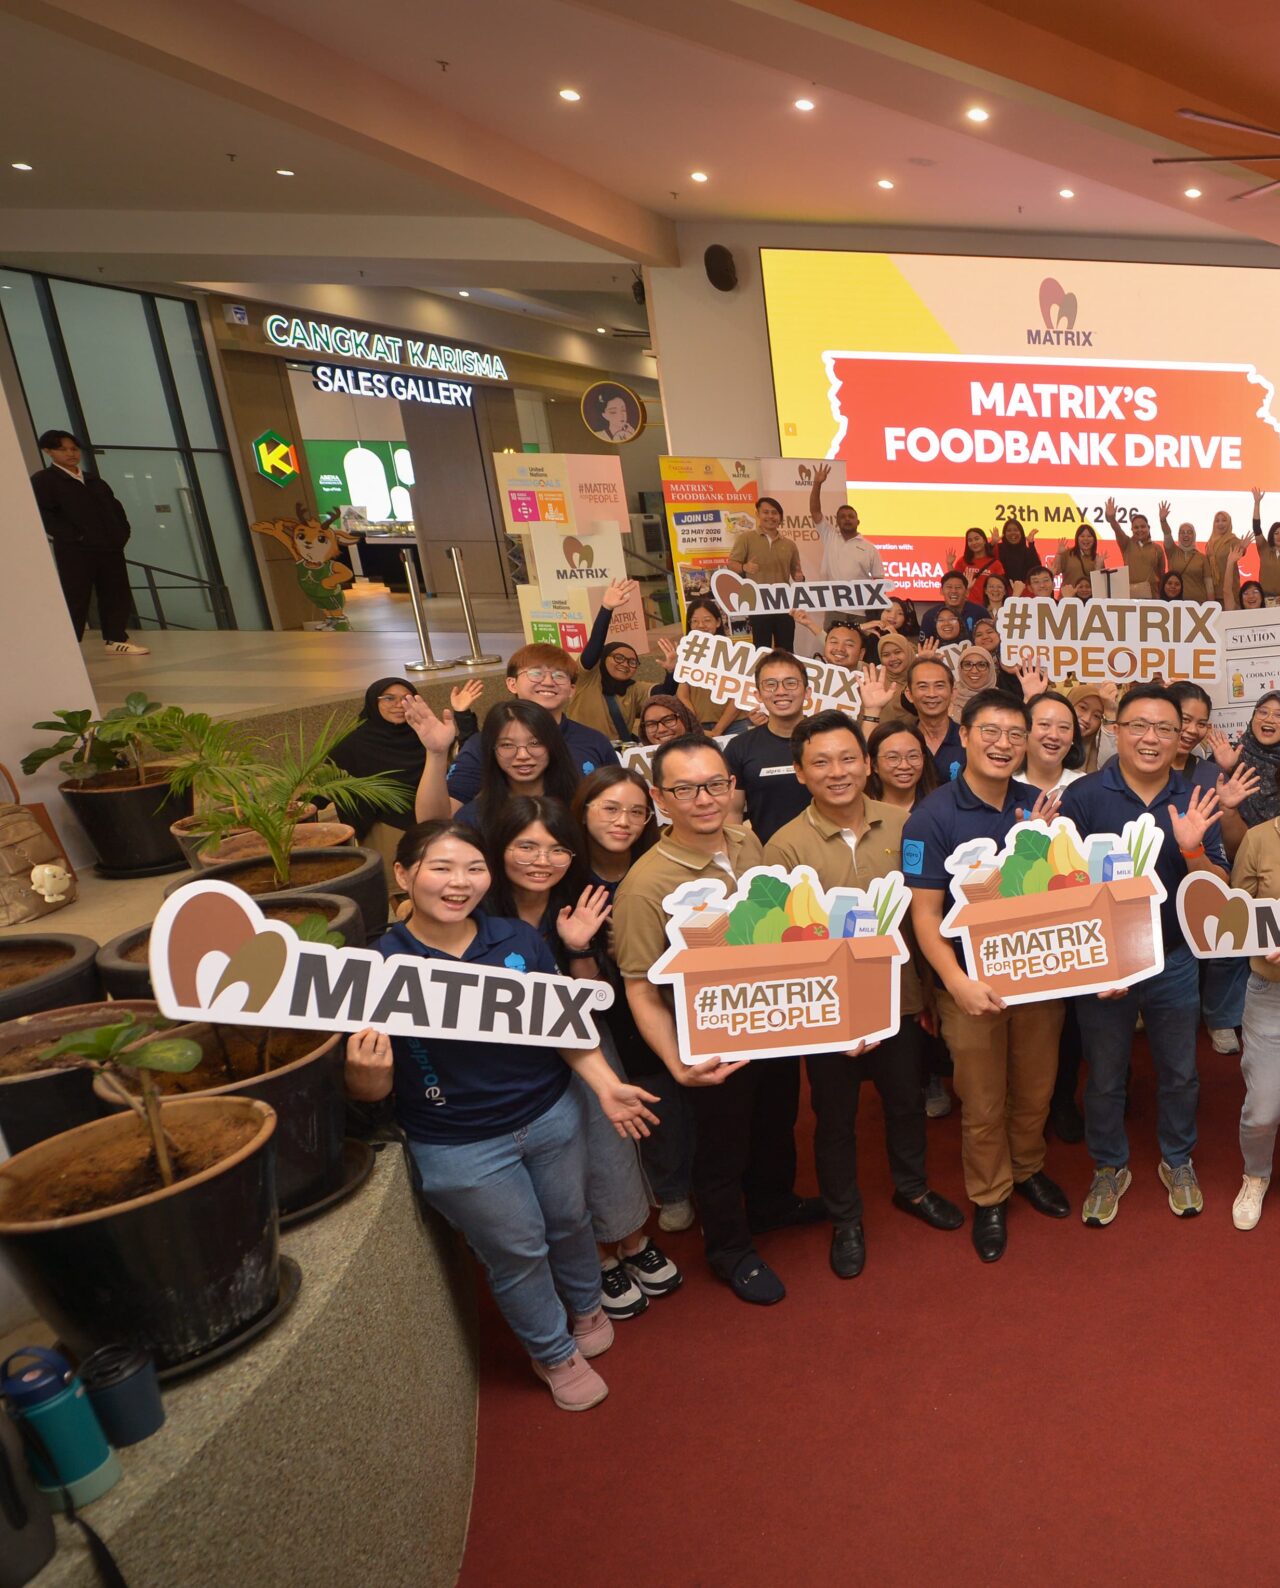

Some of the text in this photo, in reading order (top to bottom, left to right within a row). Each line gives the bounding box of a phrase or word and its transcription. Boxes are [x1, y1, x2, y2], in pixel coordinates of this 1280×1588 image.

[264, 315, 508, 380] CANGKAT KARISMA
[1027, 329, 1093, 346] MATRIX
[316, 366, 473, 407] SALES GALLERY
[970, 381, 1158, 421] MATRIX'S
[884, 426, 1242, 469] FOODBANK DRIVE
[578, 483, 618, 494] #MATRIX
[670, 484, 714, 492] MATRIX'S
[671, 492, 753, 501] FOODBANK DRIVE
[588, 494, 620, 503] PEOPLE
[680, 513, 714, 523] JOIN US
[995, 504, 1039, 523] 23th
[1043, 506, 1088, 523] MAY
[556, 568, 608, 580] MATRIX
[881, 562, 945, 578] ECHARA
[893, 579, 942, 589] oup kitche
[758, 583, 889, 610] MATRIX
[610, 621, 640, 634] PEOPLE
[611, 611, 638, 624] ATRIX
[1002, 603, 1217, 644] #MATRIX
[1232, 631, 1277, 643] STATION
[682, 635, 857, 703] #MRIX
[1007, 645, 1217, 680] FOR PEOPLE
[679, 665, 718, 686] FOR
[1245, 671, 1276, 679] COOKING
[983, 922, 1101, 961] #MATRIX
[986, 945, 1105, 977] FOR PEOPLE
[288, 952, 595, 1040] MATRIX
[698, 979, 835, 1013] #MATRIX
[700, 1003, 837, 1032] FOR PEOPLE
